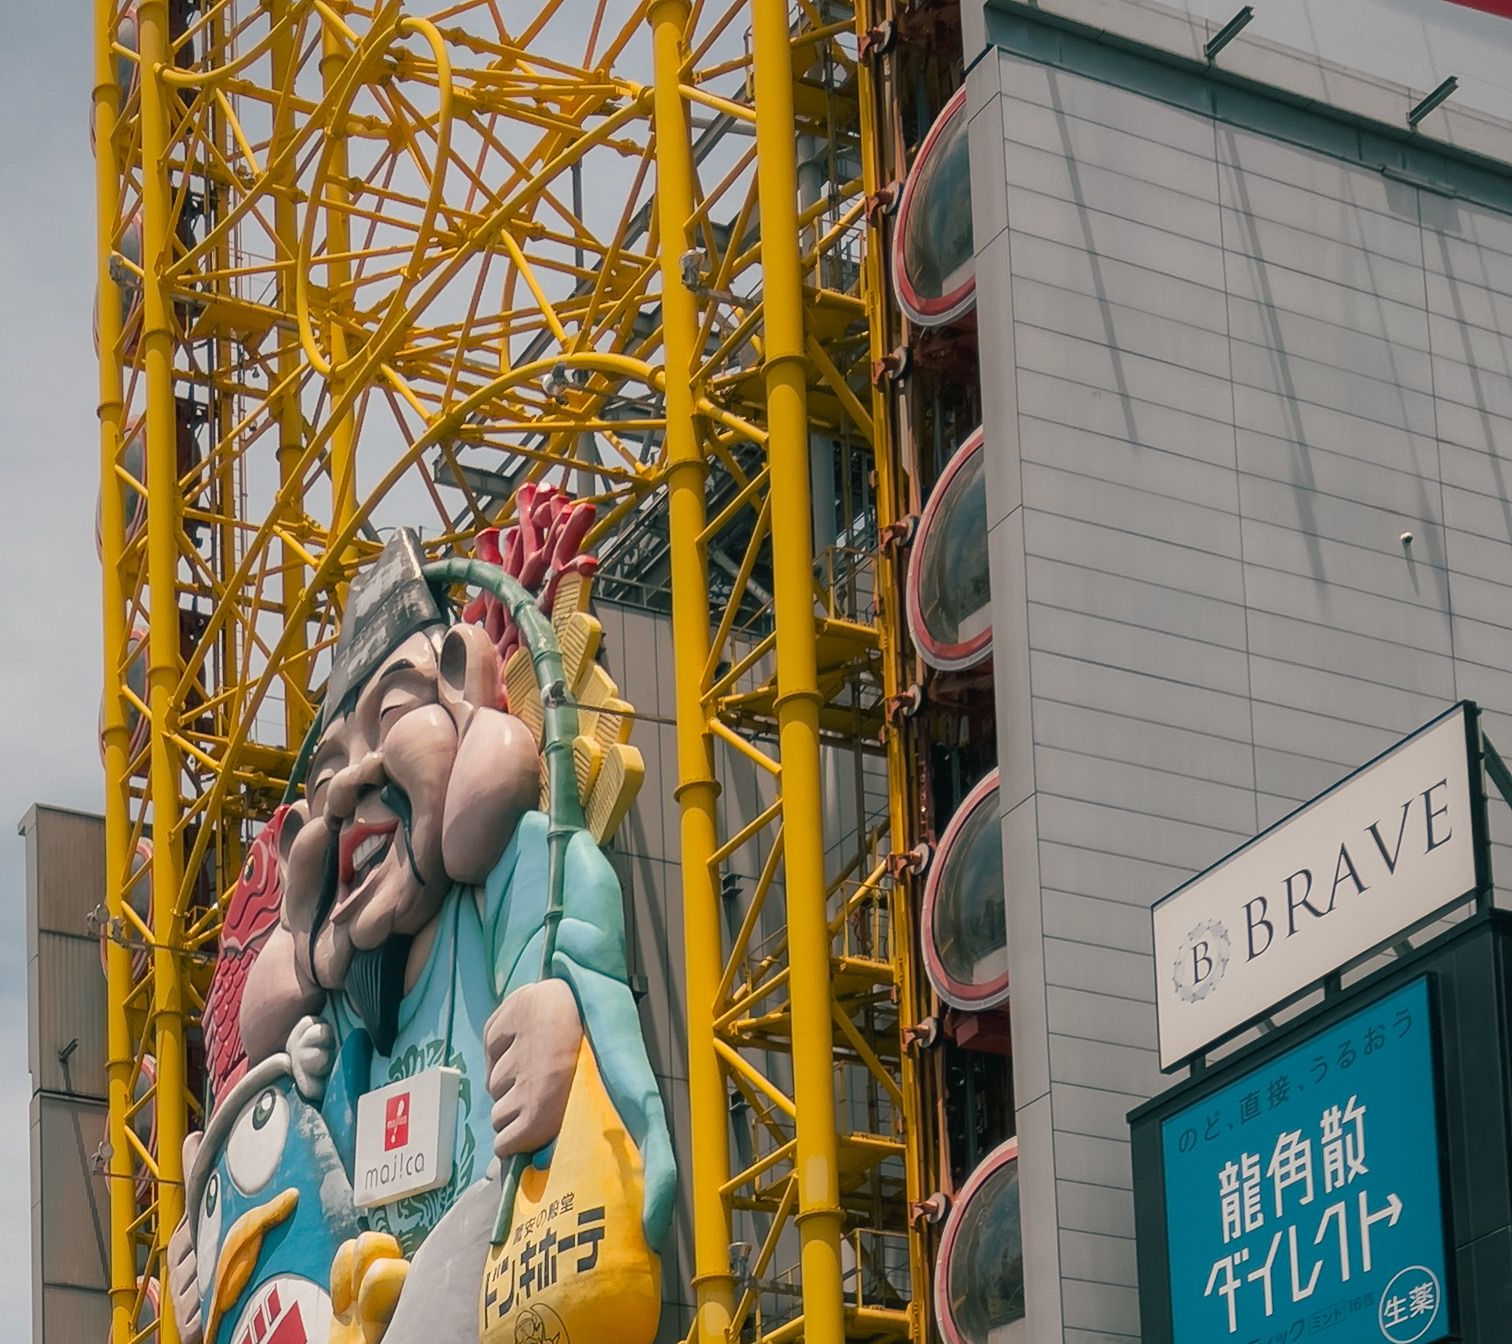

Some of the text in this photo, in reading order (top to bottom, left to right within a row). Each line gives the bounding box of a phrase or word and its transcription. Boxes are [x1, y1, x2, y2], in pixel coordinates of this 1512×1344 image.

[1242, 778, 1453, 964] BRAVE
[1217, 1093, 1369, 1245] 龍角散
[1202, 1191, 1403, 1335] ダイレクト
[1383, 1281, 1435, 1329] 生薬
